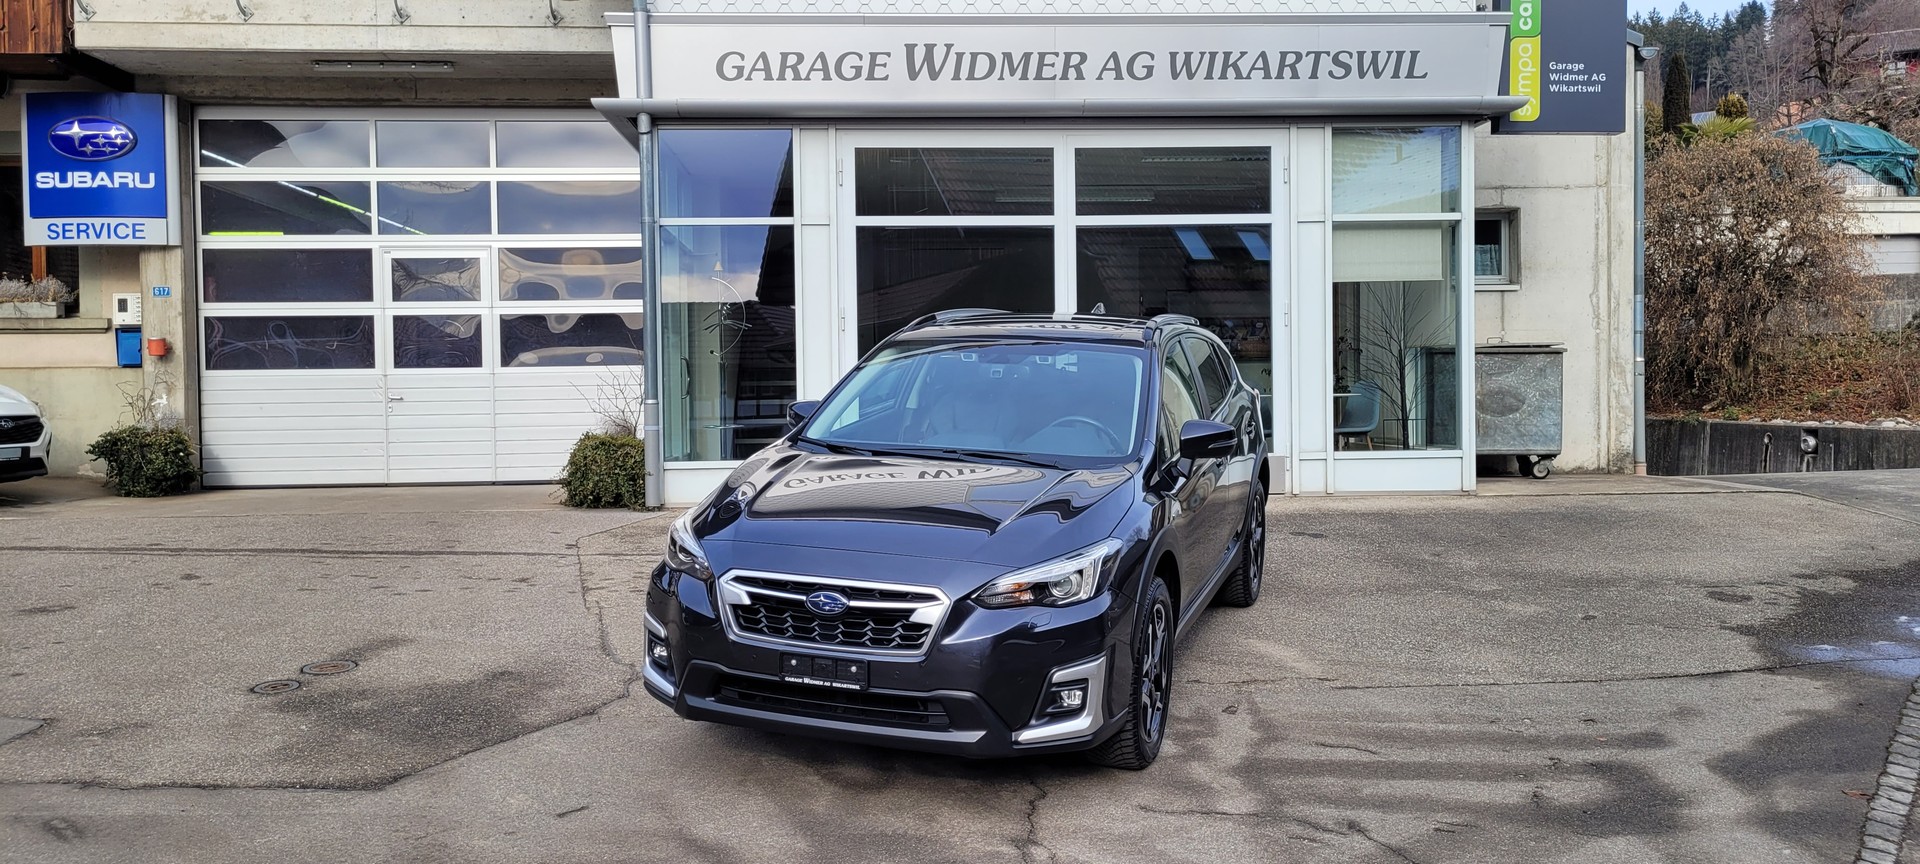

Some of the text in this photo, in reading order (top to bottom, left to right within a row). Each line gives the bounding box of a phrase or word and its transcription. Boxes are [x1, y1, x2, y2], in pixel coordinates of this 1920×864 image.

[1519, 0, 1532, 31] ca
[715, 43, 1428, 81] GARAGE WIDMER AG WIKARTSWIL
[1549, 61, 1585, 71] Garage
[1549, 73, 1606, 81] Widmer AG
[1549, 84, 1601, 93] Wikartswil
[35, 172, 155, 188] SUBARU
[47, 222, 146, 240] SERVICE
[154, 287, 169, 295] 617
